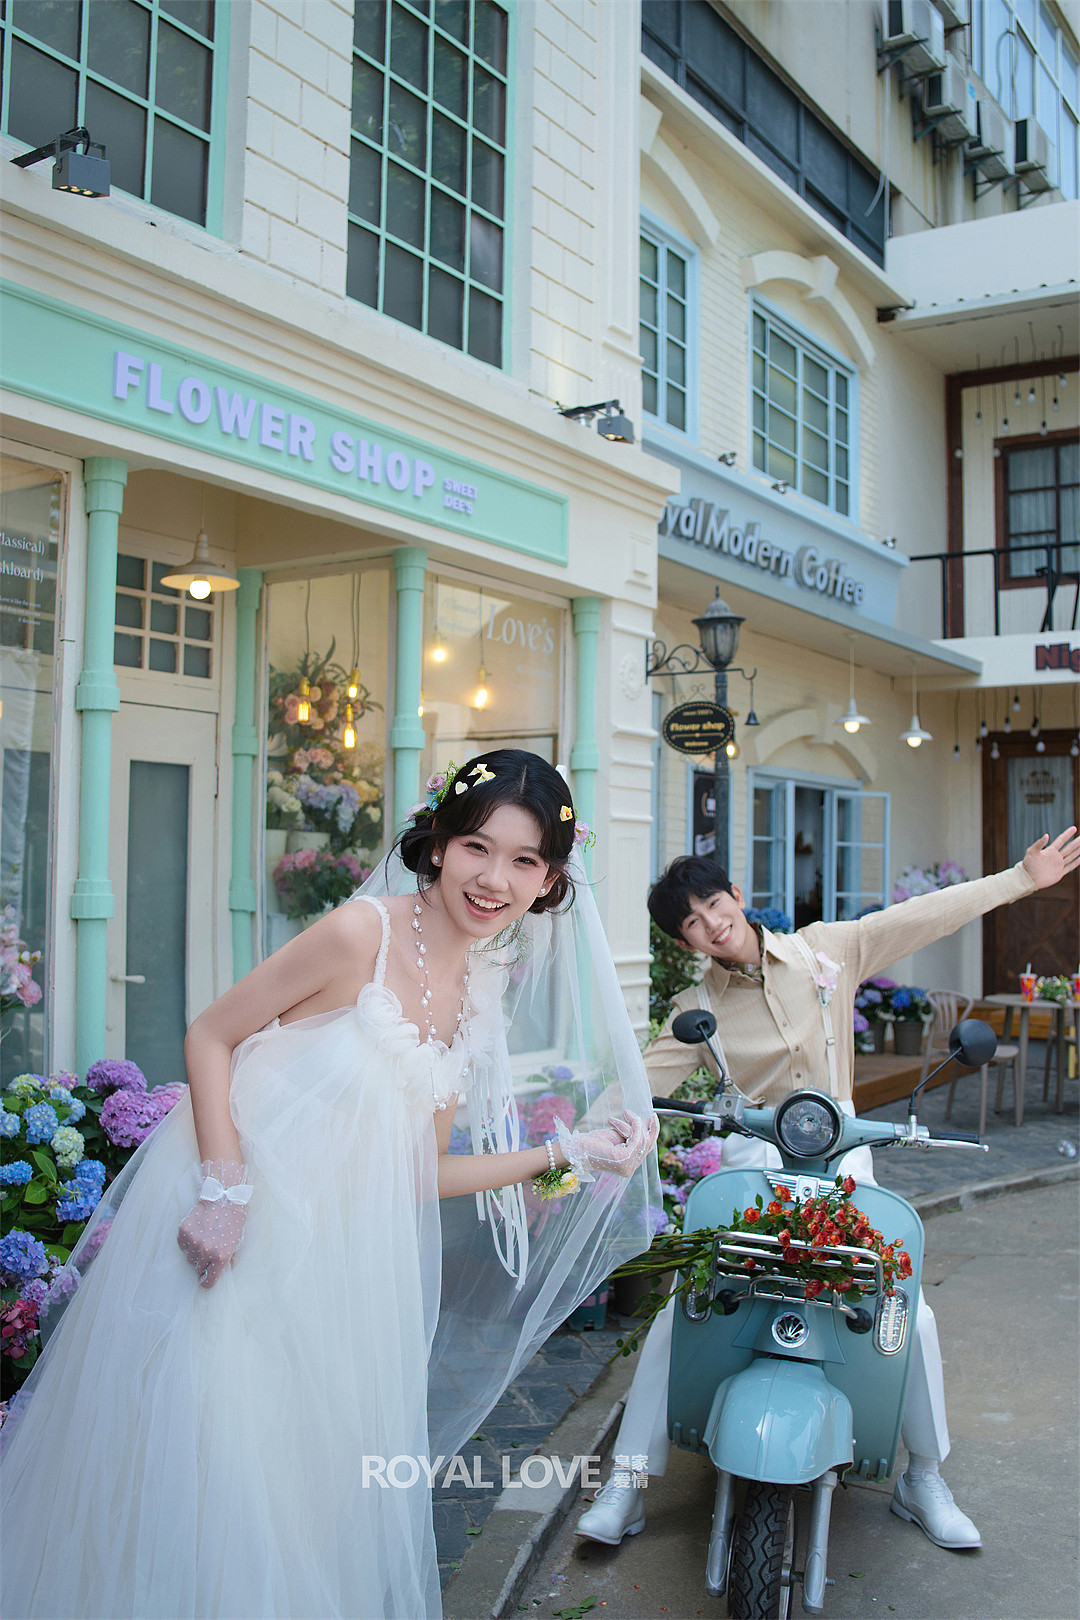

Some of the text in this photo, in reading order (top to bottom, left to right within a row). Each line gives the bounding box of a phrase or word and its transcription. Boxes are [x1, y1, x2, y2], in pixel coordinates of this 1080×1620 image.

[113, 351, 435, 498] FLOWER SHOP
[443, 478, 478, 500] SWEET
[703, 502, 793, 577] Modern
[795, 545, 865, 606] Coffee
[486, 604, 555, 654] Love's
